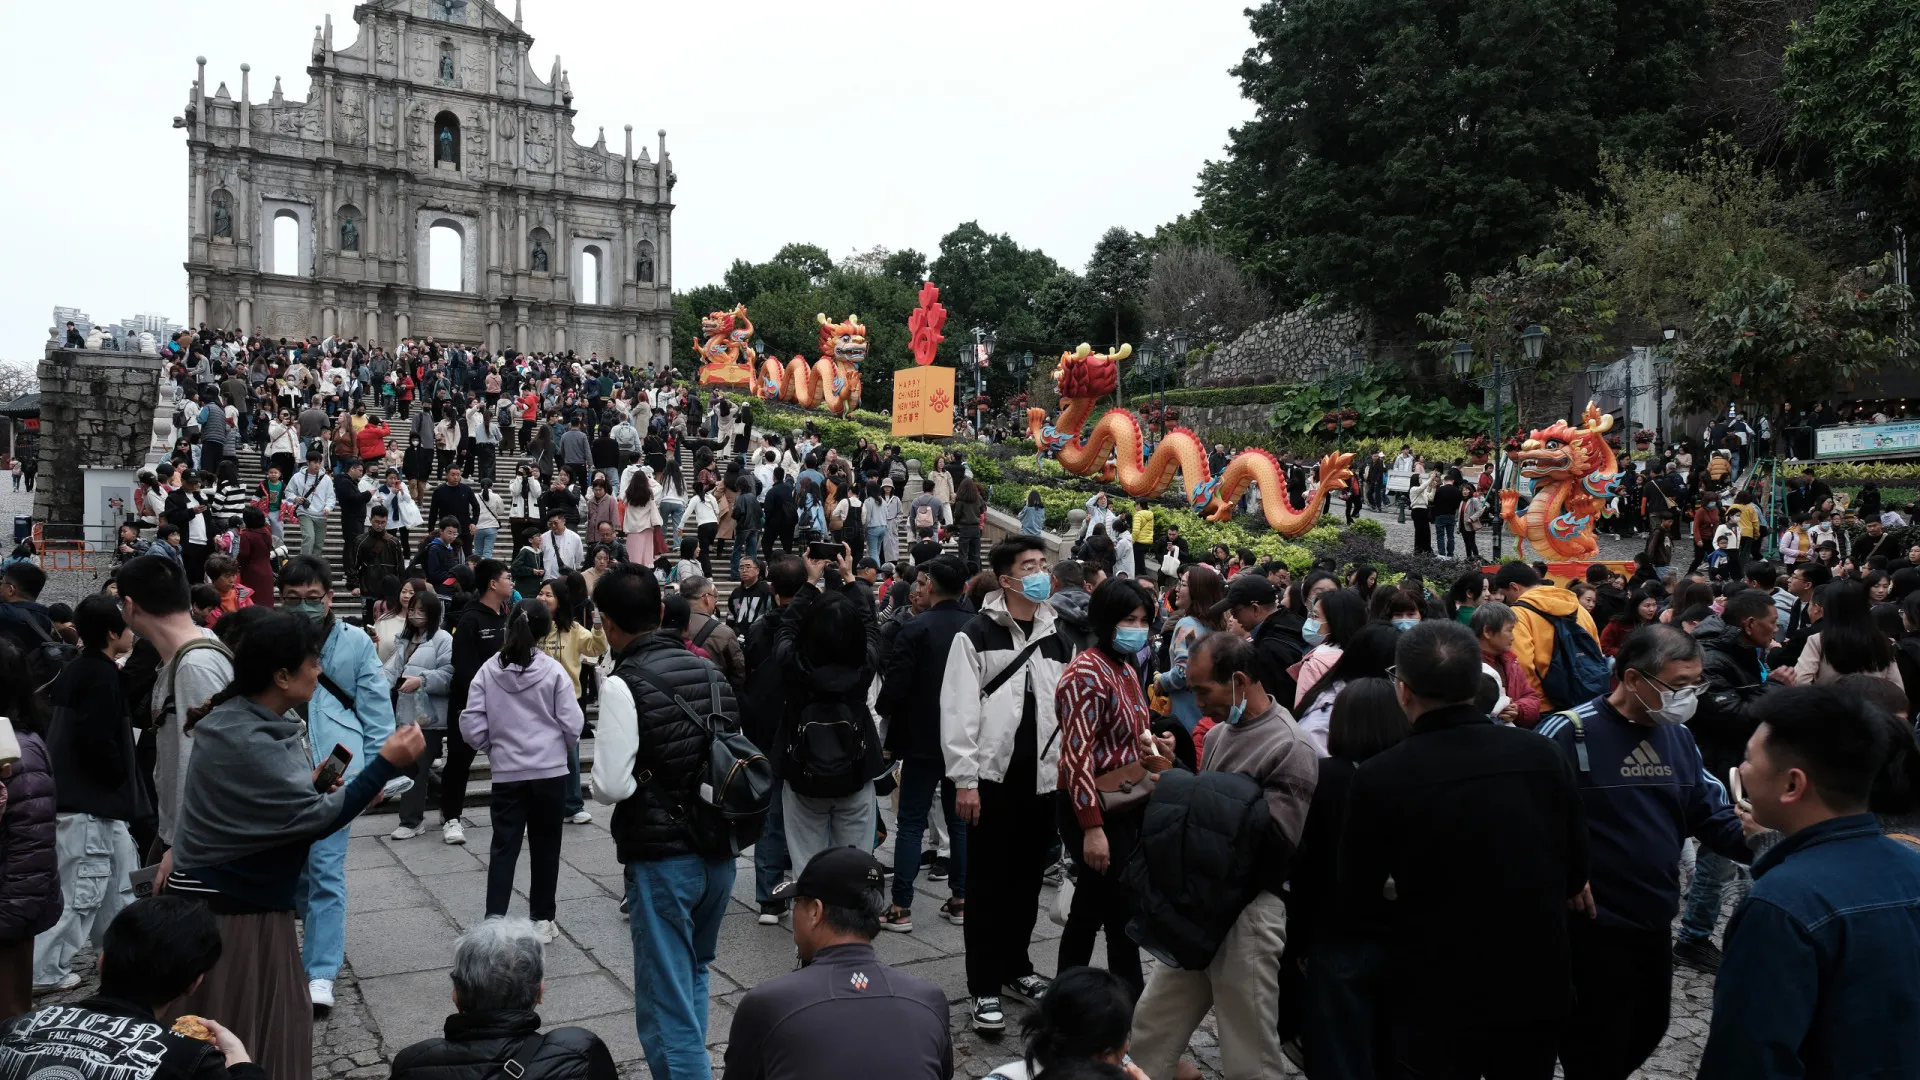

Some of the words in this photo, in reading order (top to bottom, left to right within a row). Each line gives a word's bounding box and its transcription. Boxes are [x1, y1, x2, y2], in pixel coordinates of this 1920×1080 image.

[898, 379, 920, 389] HAPPY
[898, 390, 920, 400] CHINESE
[897, 402, 908, 411] NEW
[909, 400, 920, 409] YEAR
[1620, 764, 1672, 777] adidas
